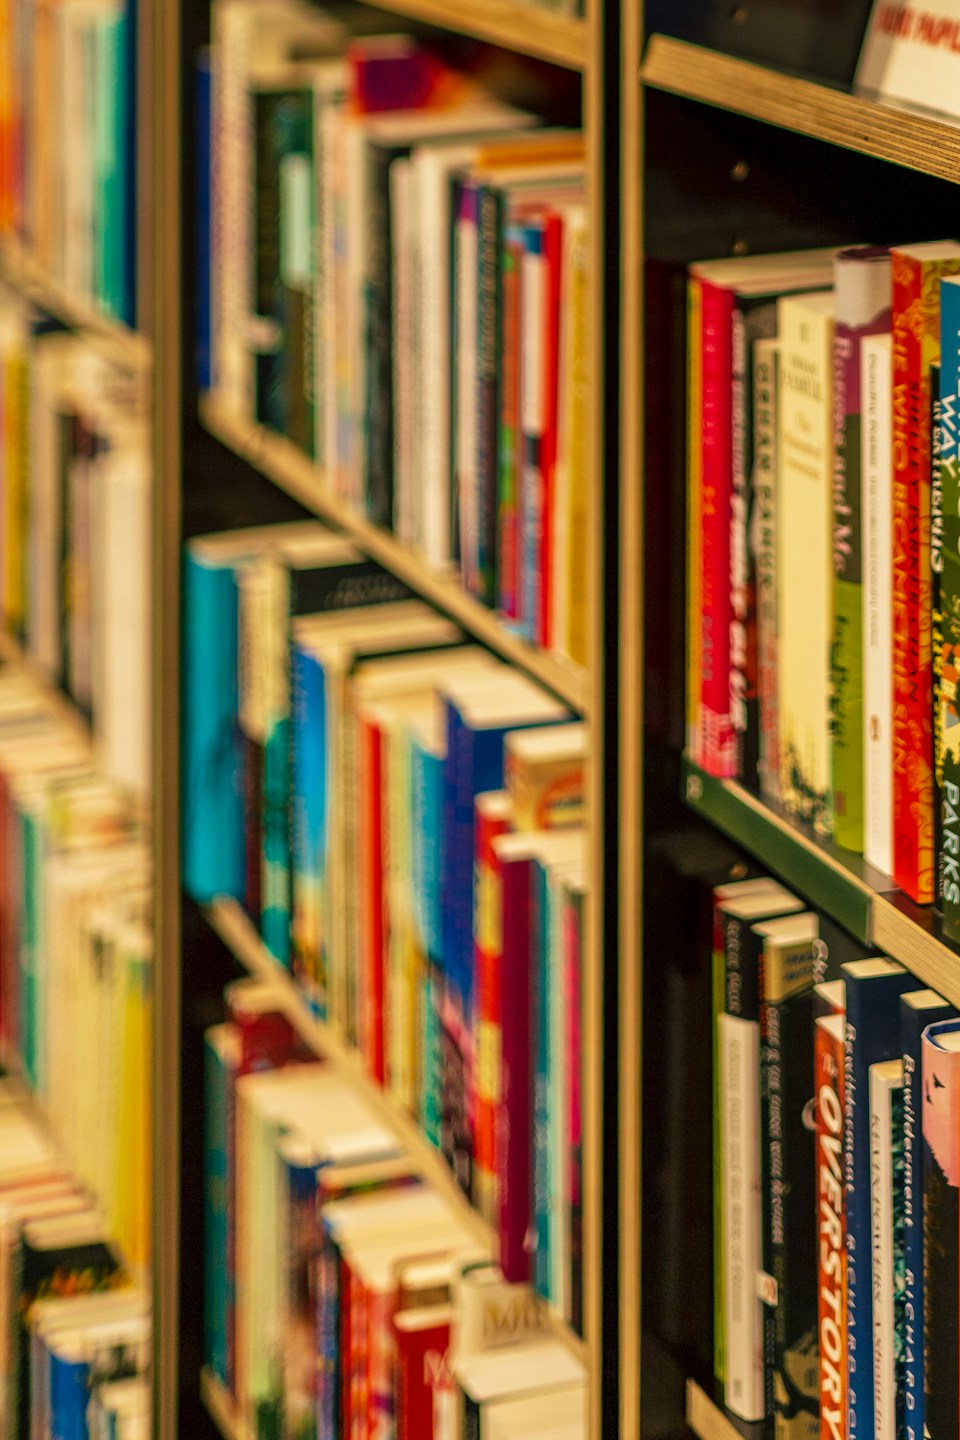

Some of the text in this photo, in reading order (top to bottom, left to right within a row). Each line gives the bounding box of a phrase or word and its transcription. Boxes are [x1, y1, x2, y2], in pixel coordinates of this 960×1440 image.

[892, 383, 909, 472] WHO
[939, 393, 957, 479] WAY
[892, 482, 909, 619] BECAME
[908, 380, 921, 701] SHELLEY PARKER CHAN
[892, 627, 909, 692] THE
[892, 702, 909, 774] SUN
[943, 779, 960, 905] PARKS
[844, 1022, 857, 1194] Bewilderment
[819, 1083, 844, 1440] OVERSTORY
[903, 1053, 916, 1412] Bewilderment RICHARD
[846, 1232, 857, 1375] RICHARD
